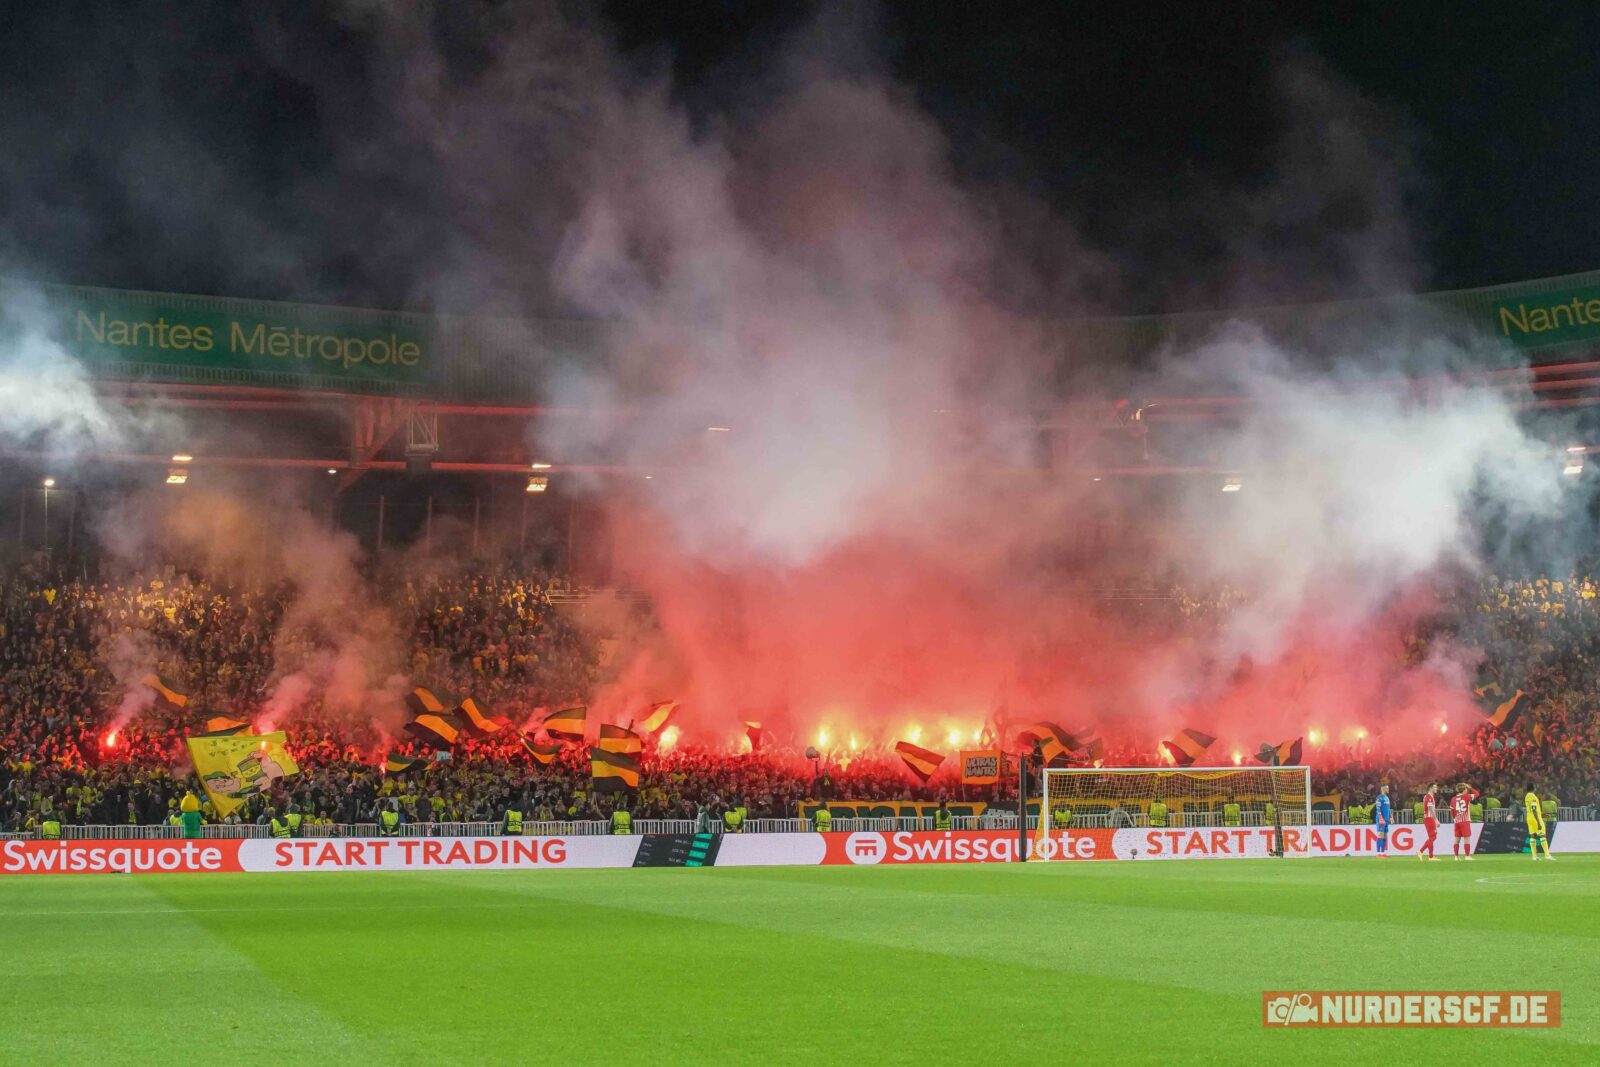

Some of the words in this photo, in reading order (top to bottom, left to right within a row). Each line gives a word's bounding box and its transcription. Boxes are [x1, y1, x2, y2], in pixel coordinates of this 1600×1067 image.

[75, 309, 214, 352] Nantes
[965, 767, 997, 778] NANTES
[966, 757, 997, 767] ULTRAS
[1455, 799, 1467, 812] 42
[275, 841, 390, 867] START
[397, 838, 567, 864] TRADING
[892, 831, 1097, 862] Swissquote
[1146, 830, 1252, 855] START
[1259, 827, 1415, 854] TRADING
[3, 840, 223, 873] Swissquote
